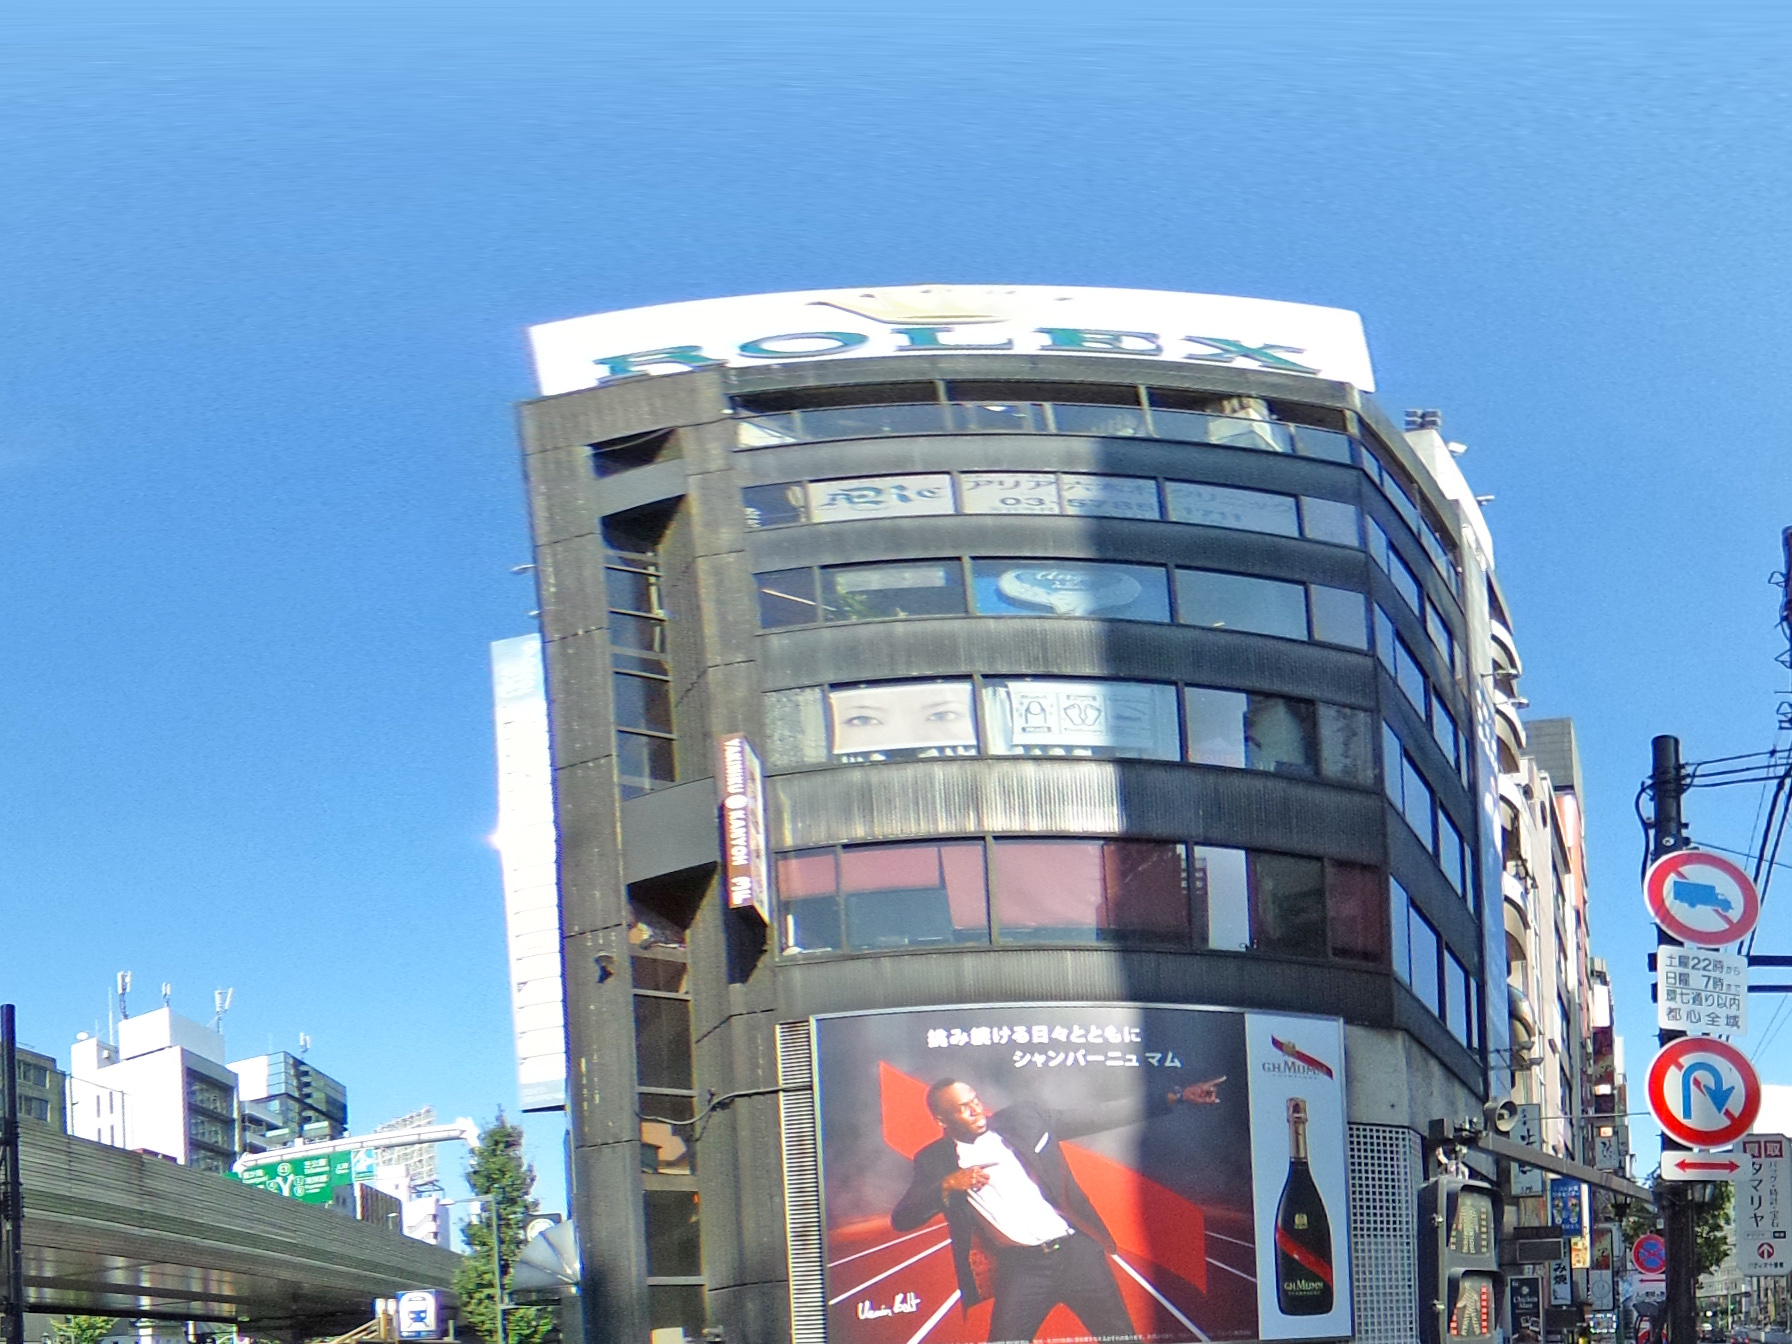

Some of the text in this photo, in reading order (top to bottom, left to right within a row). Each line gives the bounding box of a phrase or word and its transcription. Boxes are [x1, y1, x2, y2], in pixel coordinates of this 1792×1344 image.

[592, 327, 1322, 385] ROLEX
[1665, 954, 1741, 976] 土曜22時から
[1666, 1006, 1740, 1030] 都心全域
[1749, 1161, 1764, 1228] タマリヤ
